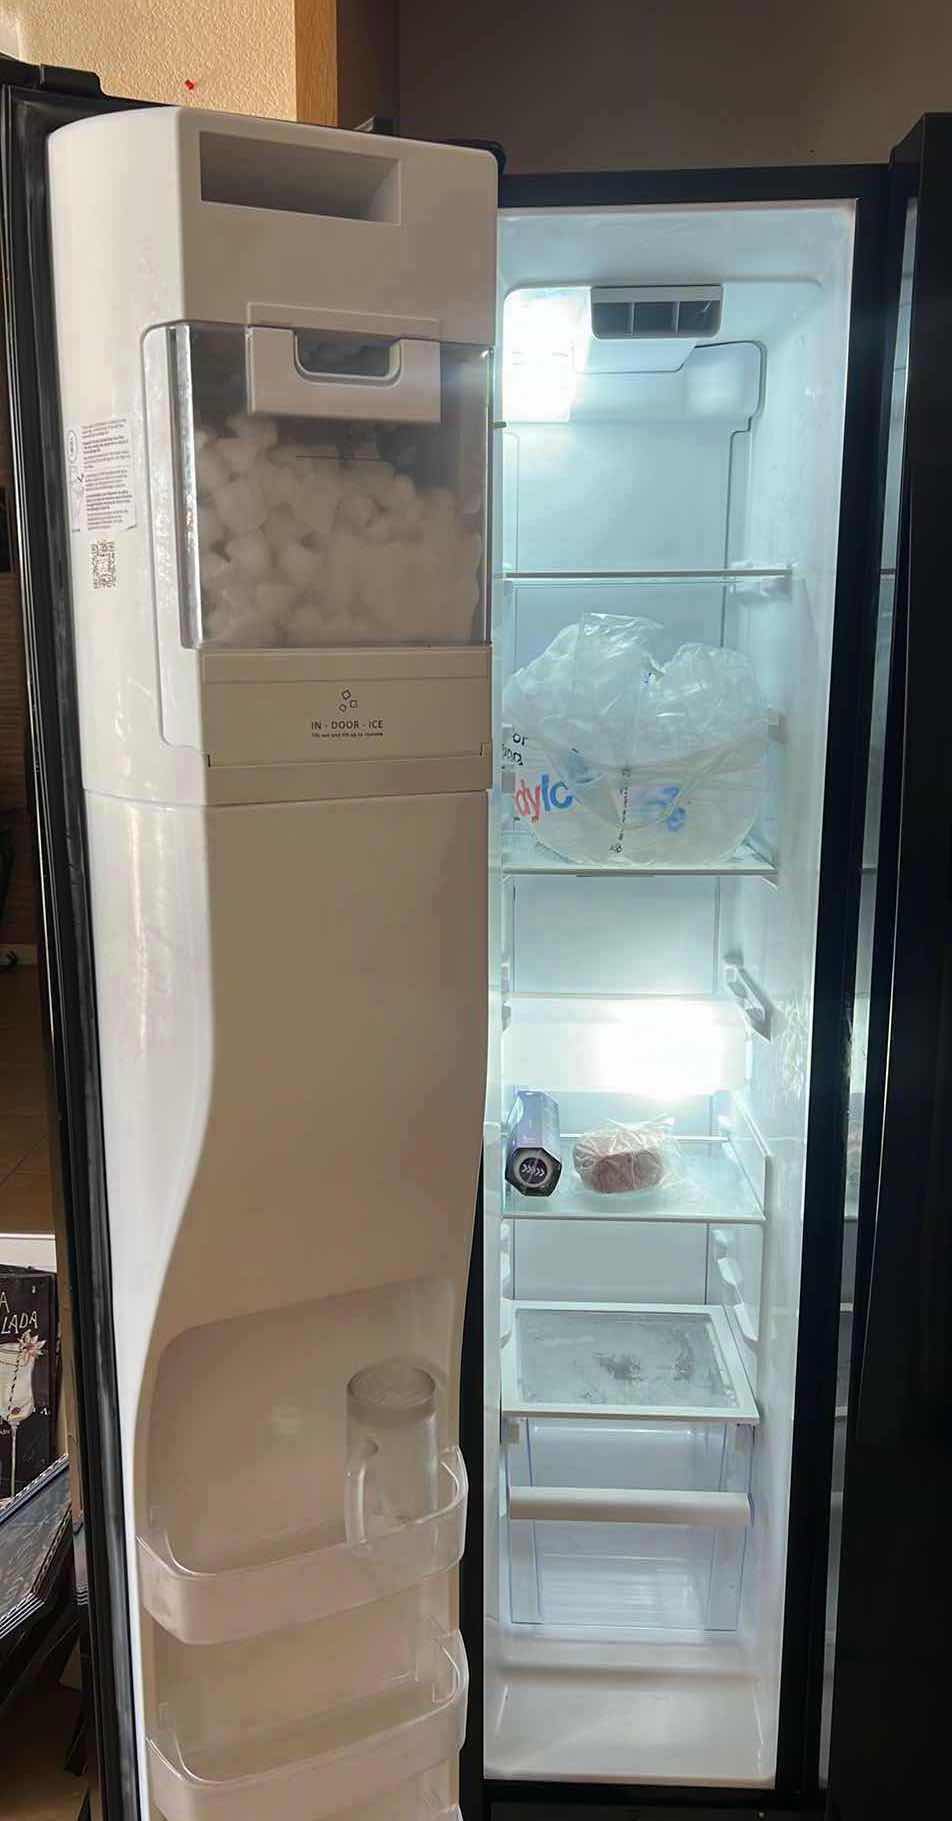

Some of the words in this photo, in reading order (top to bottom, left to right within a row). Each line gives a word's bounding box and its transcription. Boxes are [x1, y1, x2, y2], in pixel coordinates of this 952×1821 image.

[311, 720, 322, 730] IN
[331, 720, 359, 730] DOOR
[368, 719, 384, 729] ICE
[0, 1310, 38, 1335] LADA
